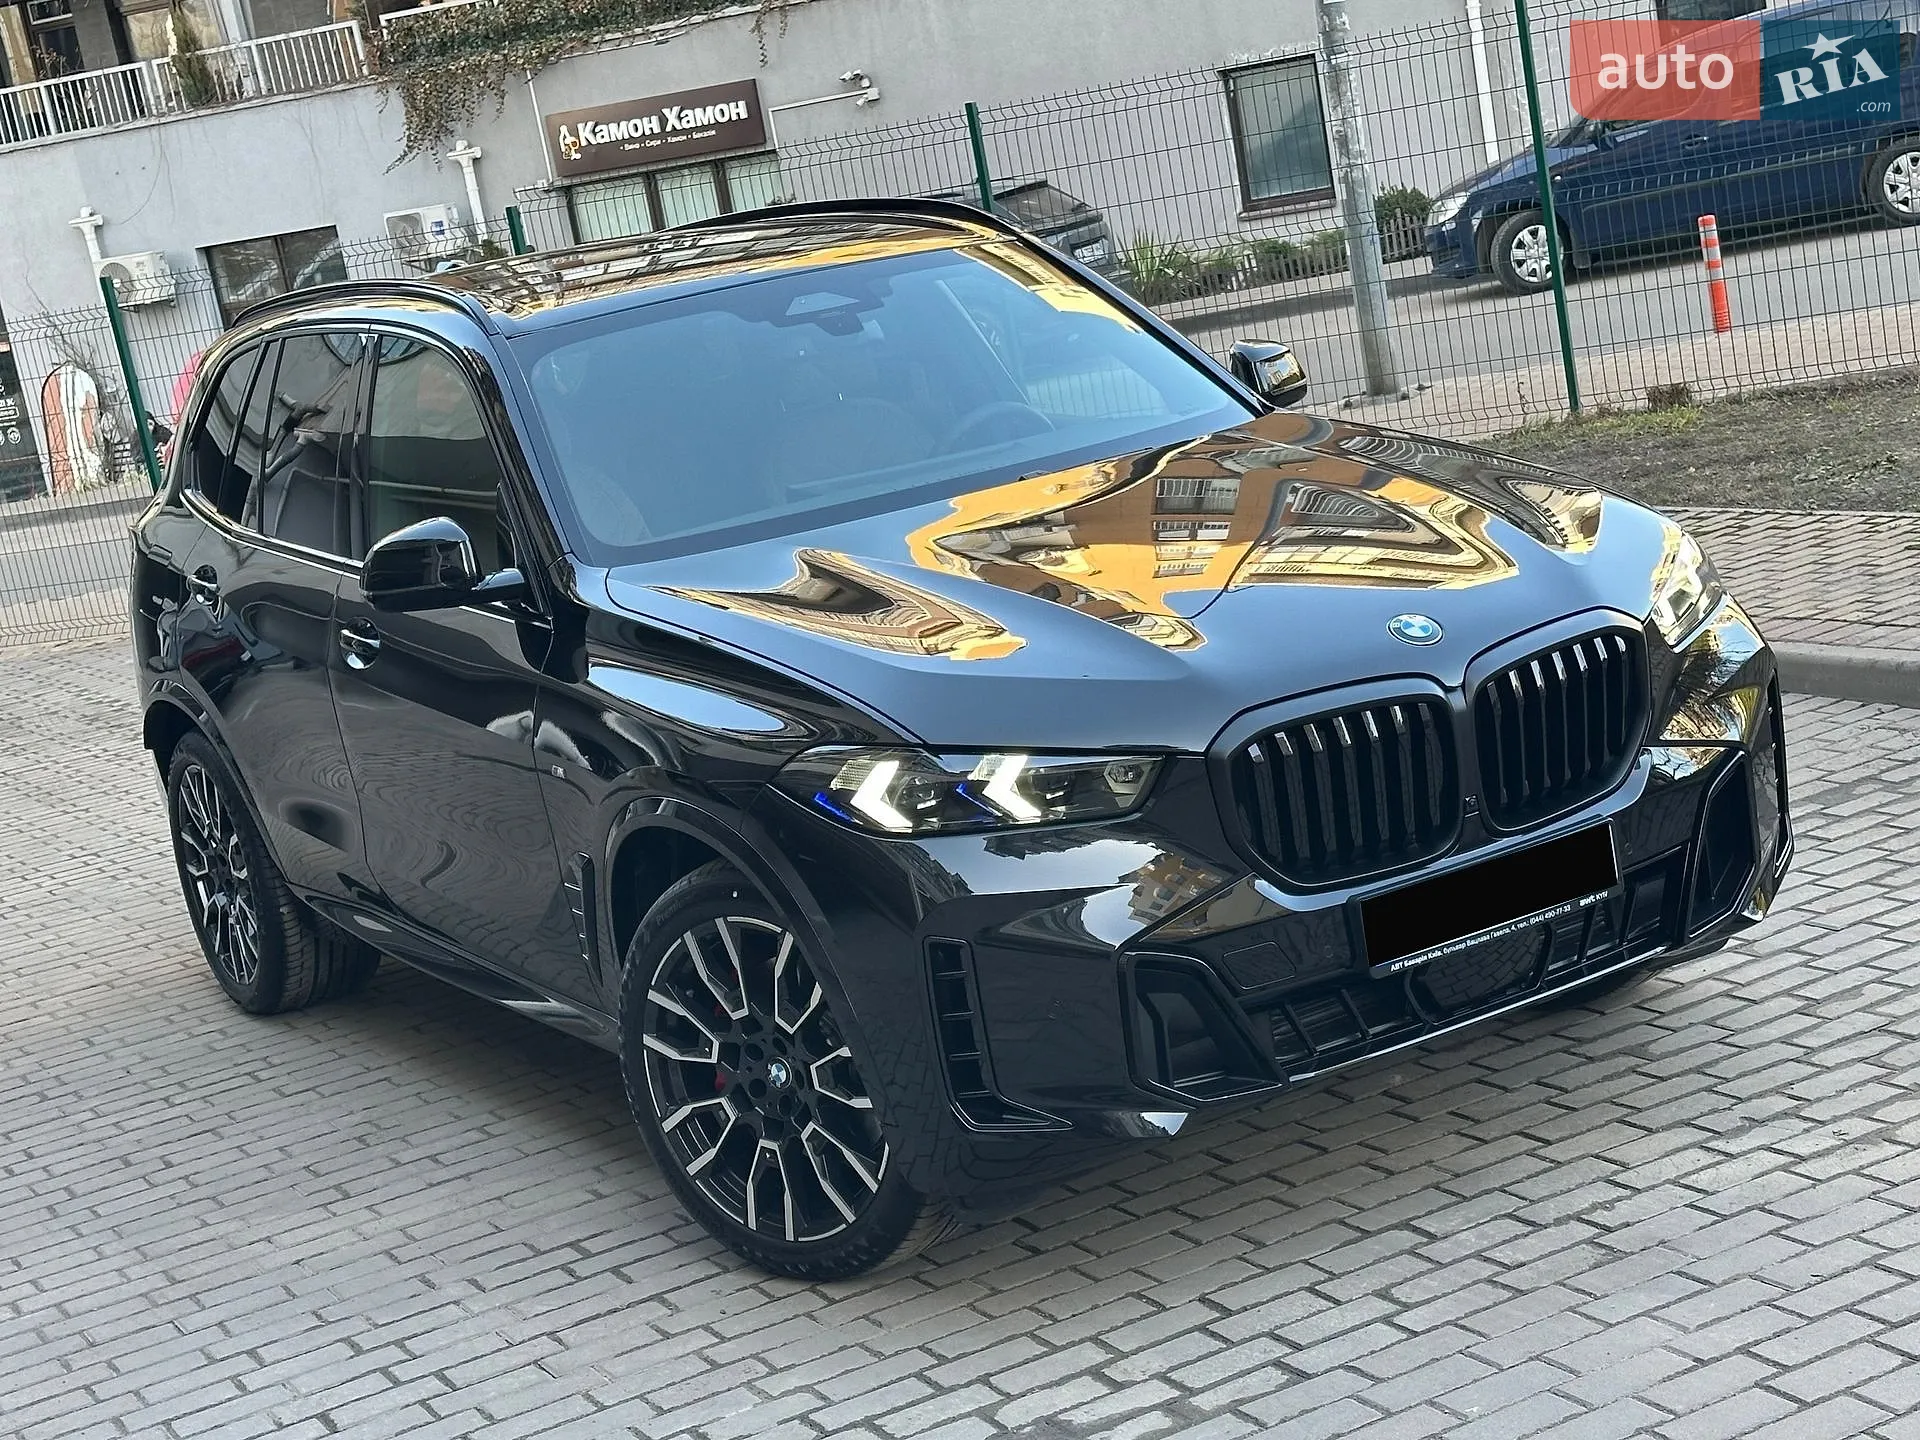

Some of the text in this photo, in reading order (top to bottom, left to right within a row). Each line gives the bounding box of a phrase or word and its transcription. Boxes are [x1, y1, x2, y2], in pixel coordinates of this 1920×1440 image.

[577, 100, 748, 147] Камон Хамон
[1529, 914, 1544, 925] (044)
